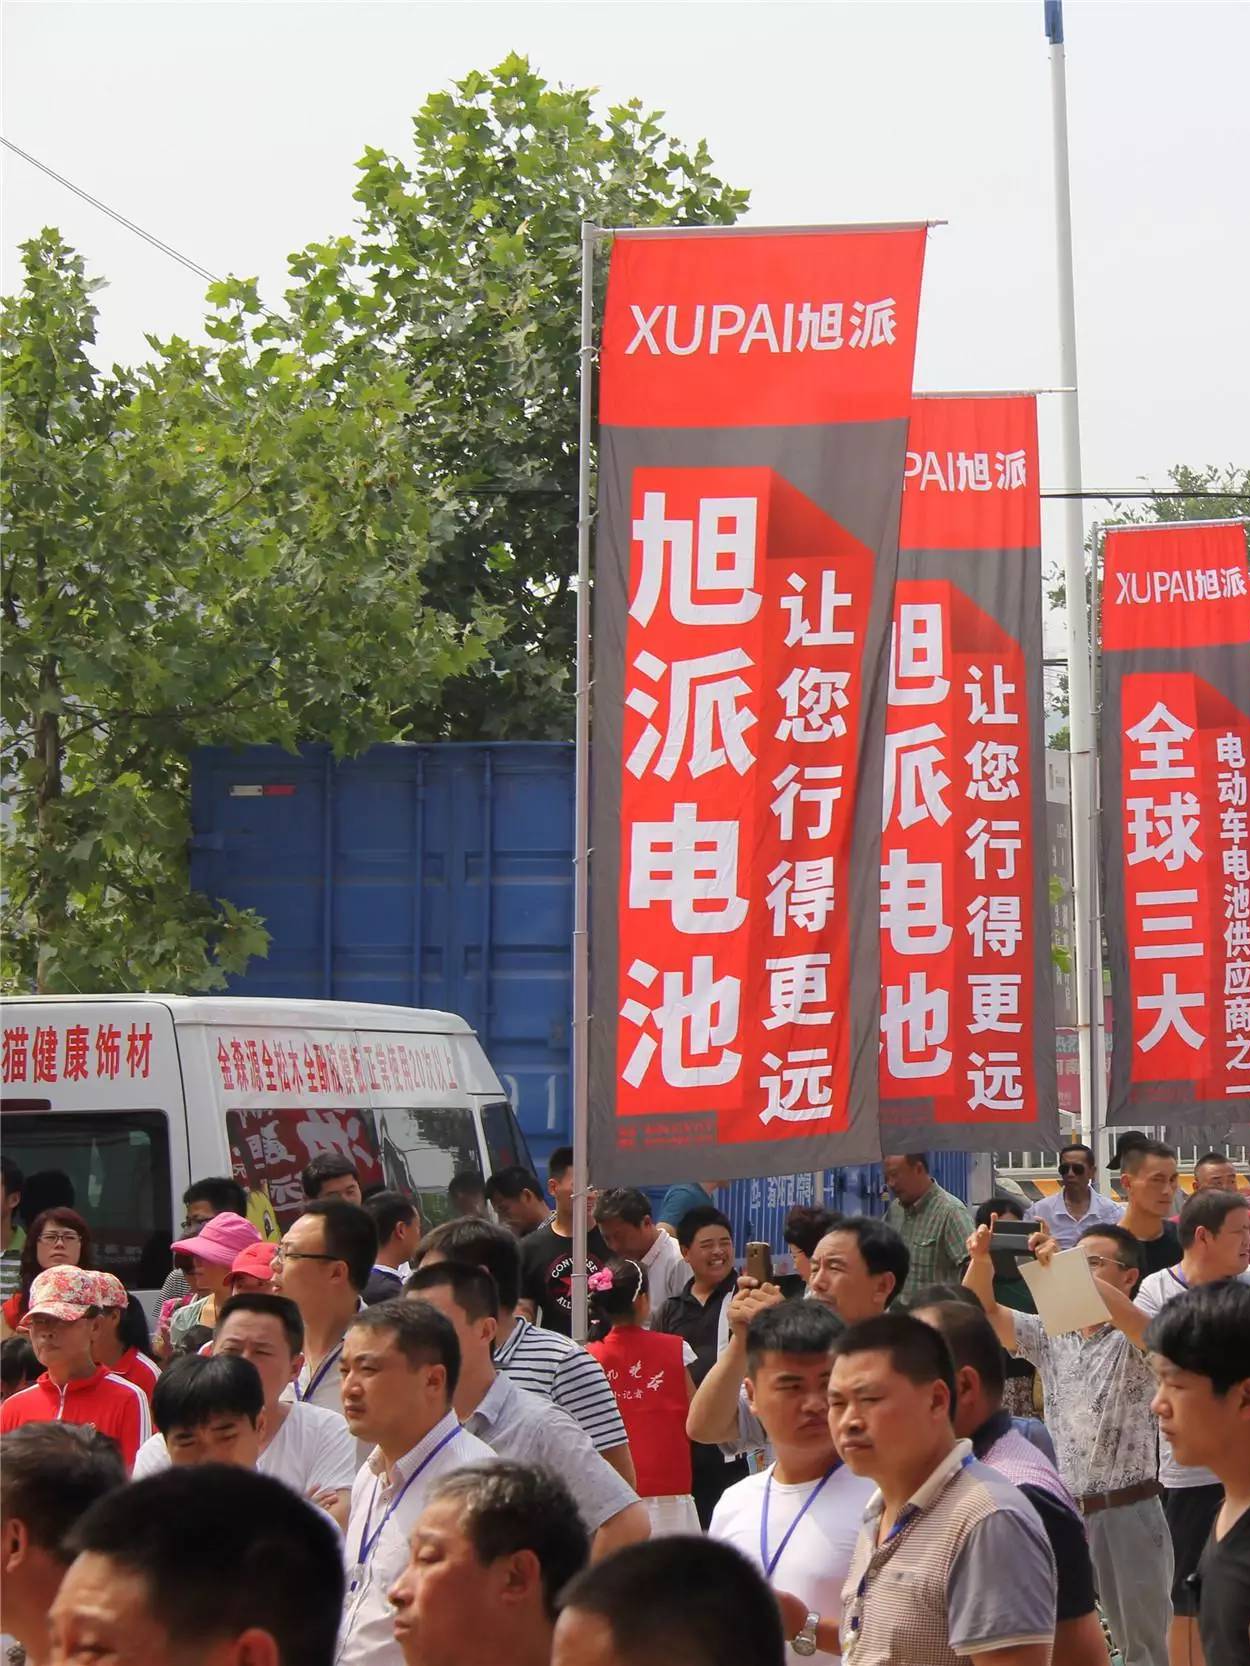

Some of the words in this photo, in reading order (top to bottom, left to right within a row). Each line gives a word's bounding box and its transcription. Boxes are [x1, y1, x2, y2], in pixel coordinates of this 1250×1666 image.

[624, 297, 898, 356] XUPAI旭派
[619, 491, 763, 1089] 旭派电池
[758, 570, 854, 1126] 让您行得更远
[963, 664, 1025, 1112] 让您行得更远
[1125, 701, 1207, 1053] 全球三大
